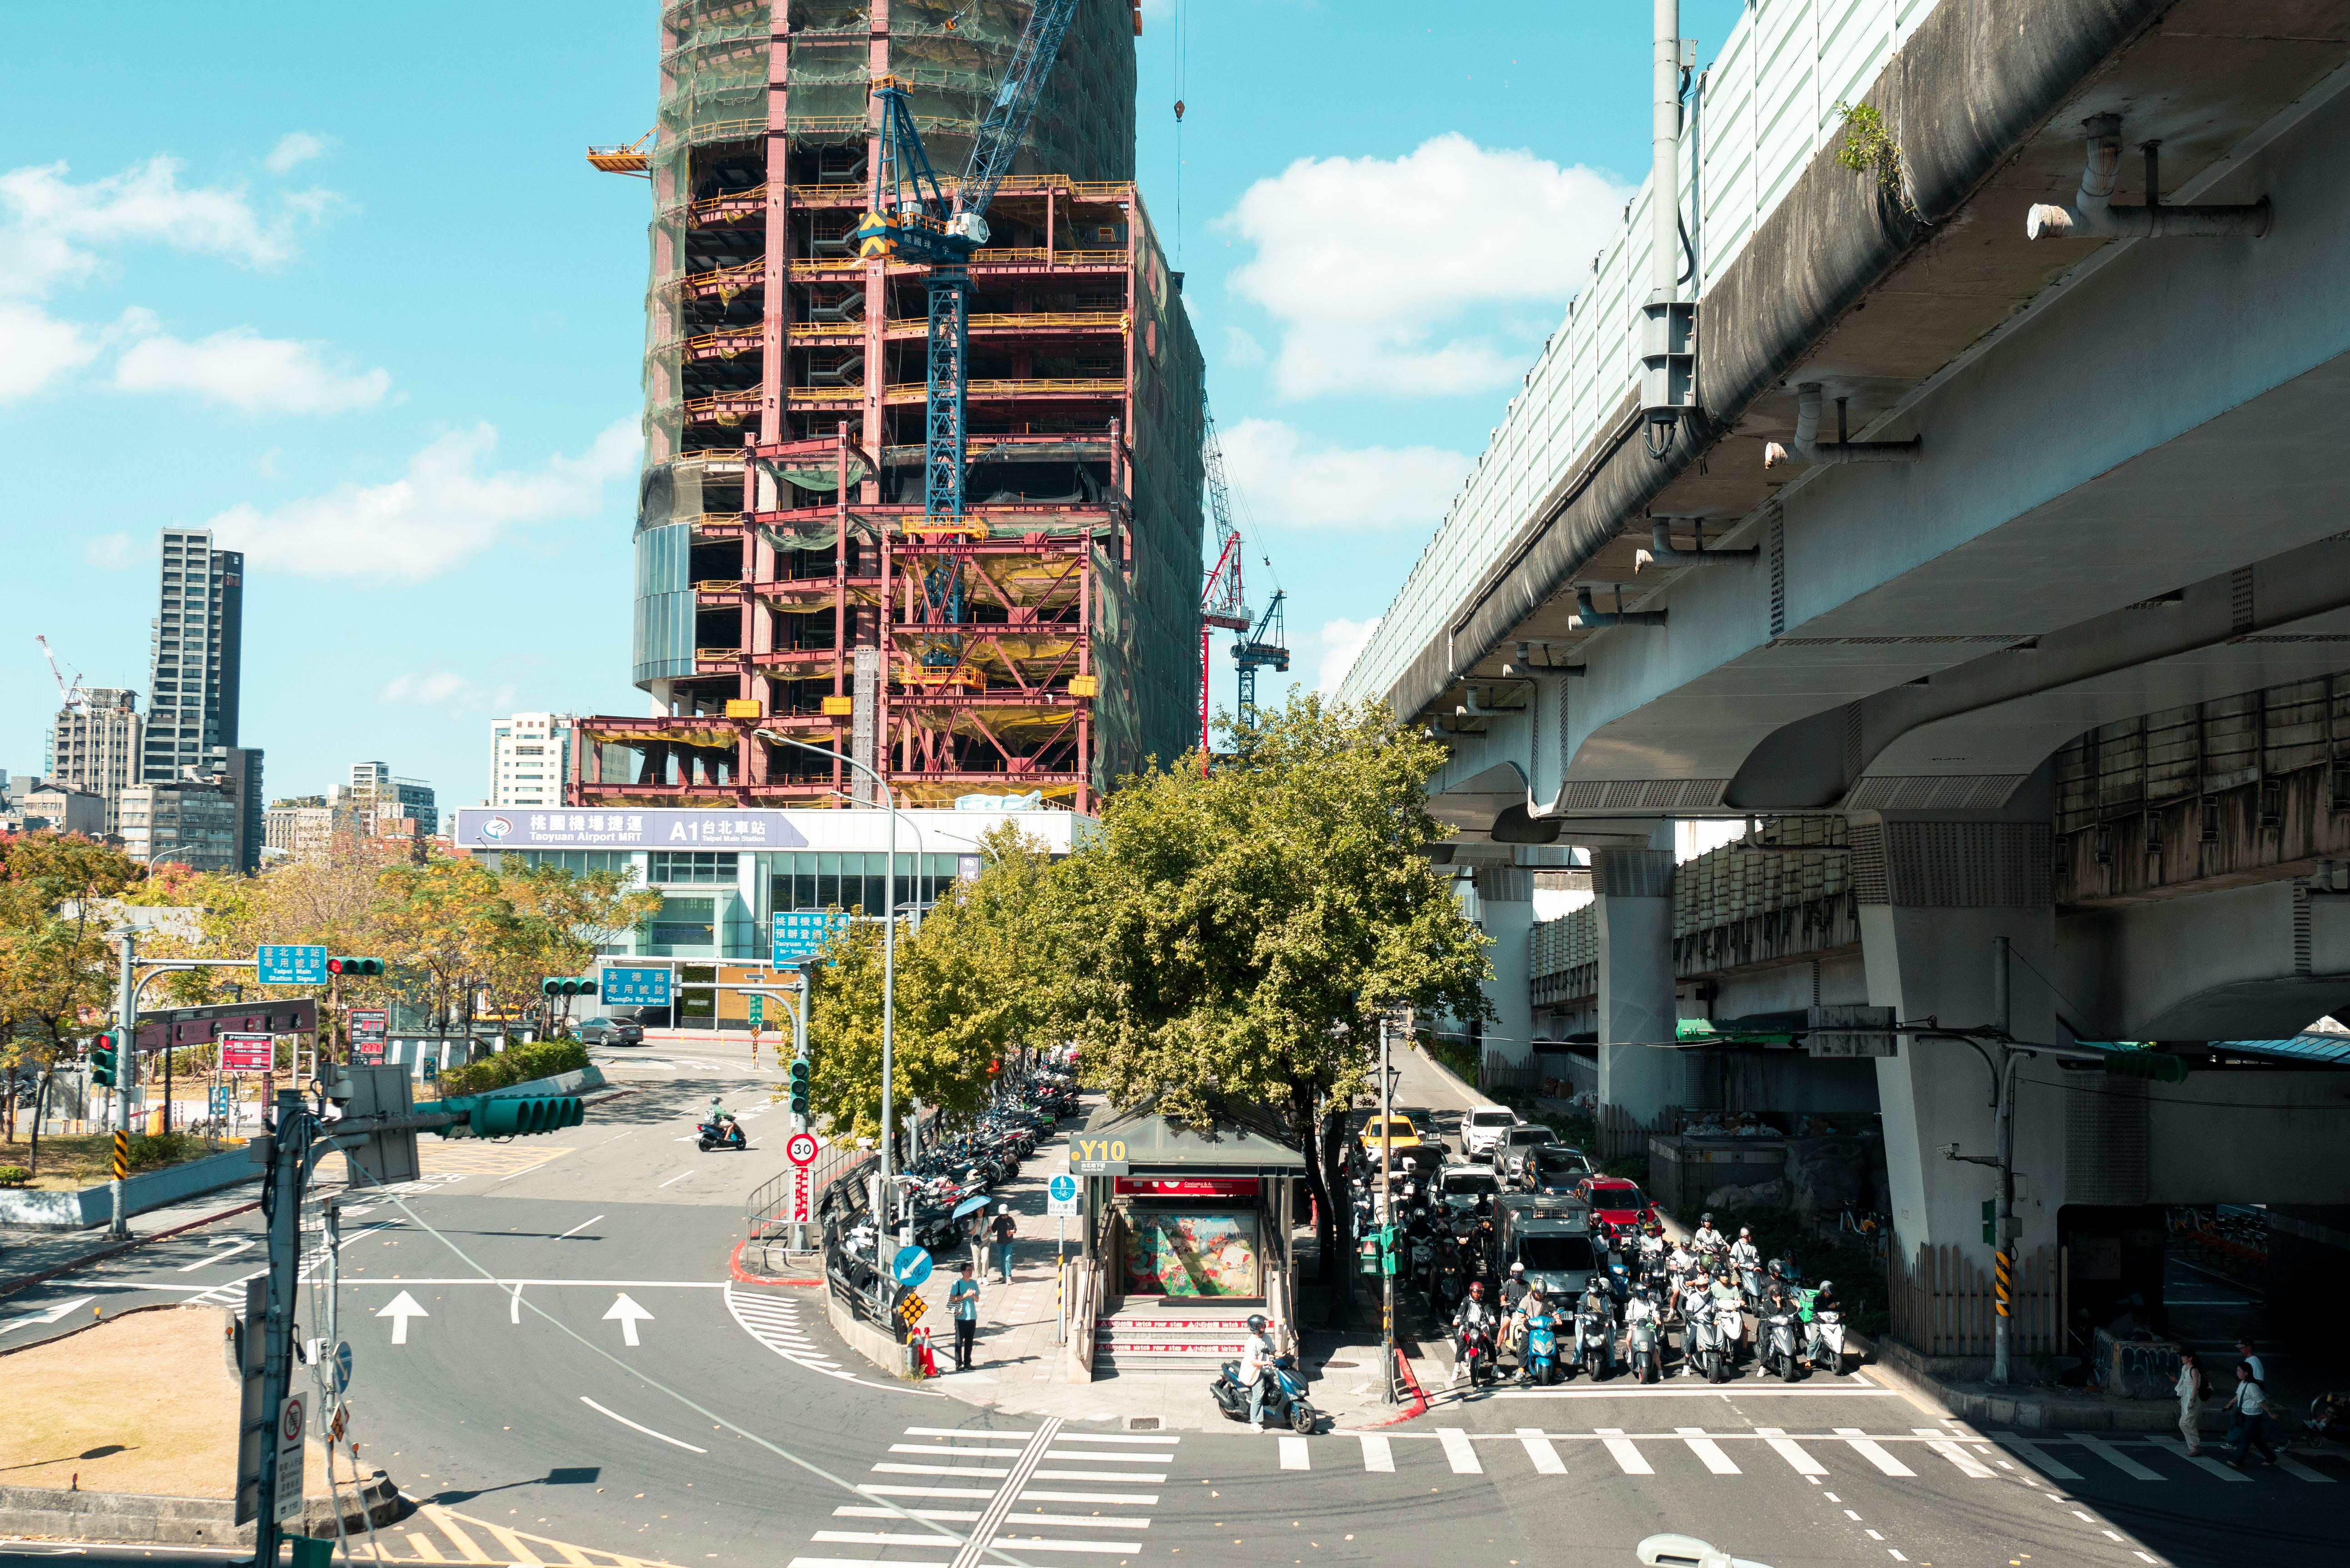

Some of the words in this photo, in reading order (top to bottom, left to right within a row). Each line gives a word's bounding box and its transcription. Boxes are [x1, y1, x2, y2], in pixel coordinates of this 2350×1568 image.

[530, 814, 643, 831] 桃園機場捷運
[702, 820, 766, 835] 台北車站
[669, 821, 698, 841] A1
[530, 832, 574, 843] Taoyuan
[579, 832, 616, 843] Airport
[618, 833, 643, 842] MRT
[264, 947, 320, 957] 臺北車站
[263, 958, 320, 968] 專用號誌
[608, 971, 665, 982] 承德路
[608, 984, 665, 995] 專用號誌
[793, 1144, 811, 1155] 30
[1079, 1140, 1126, 1161] Y10
